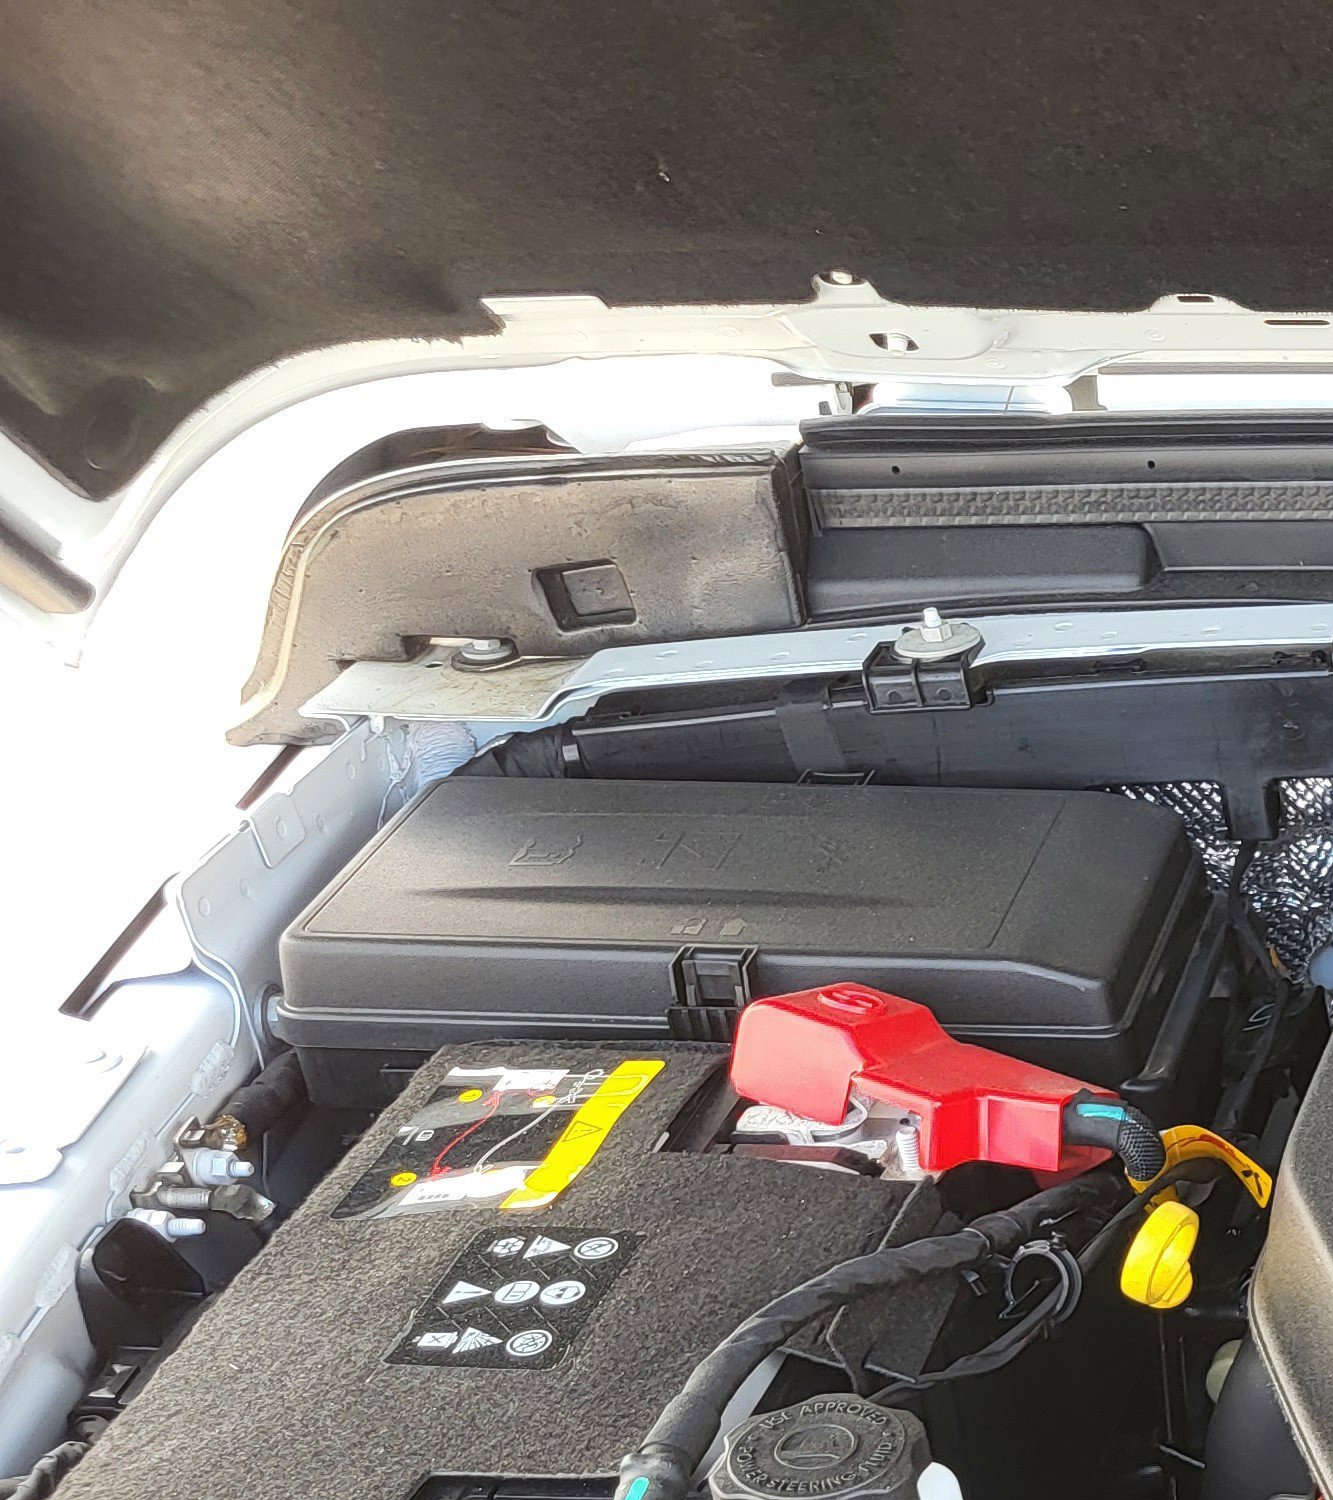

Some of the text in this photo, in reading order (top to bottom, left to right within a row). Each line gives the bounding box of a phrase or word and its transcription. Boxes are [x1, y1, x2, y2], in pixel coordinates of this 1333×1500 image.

[759, 1400, 888, 1431] USE APPROVED
[766, 1470, 857, 1493] STEERING
